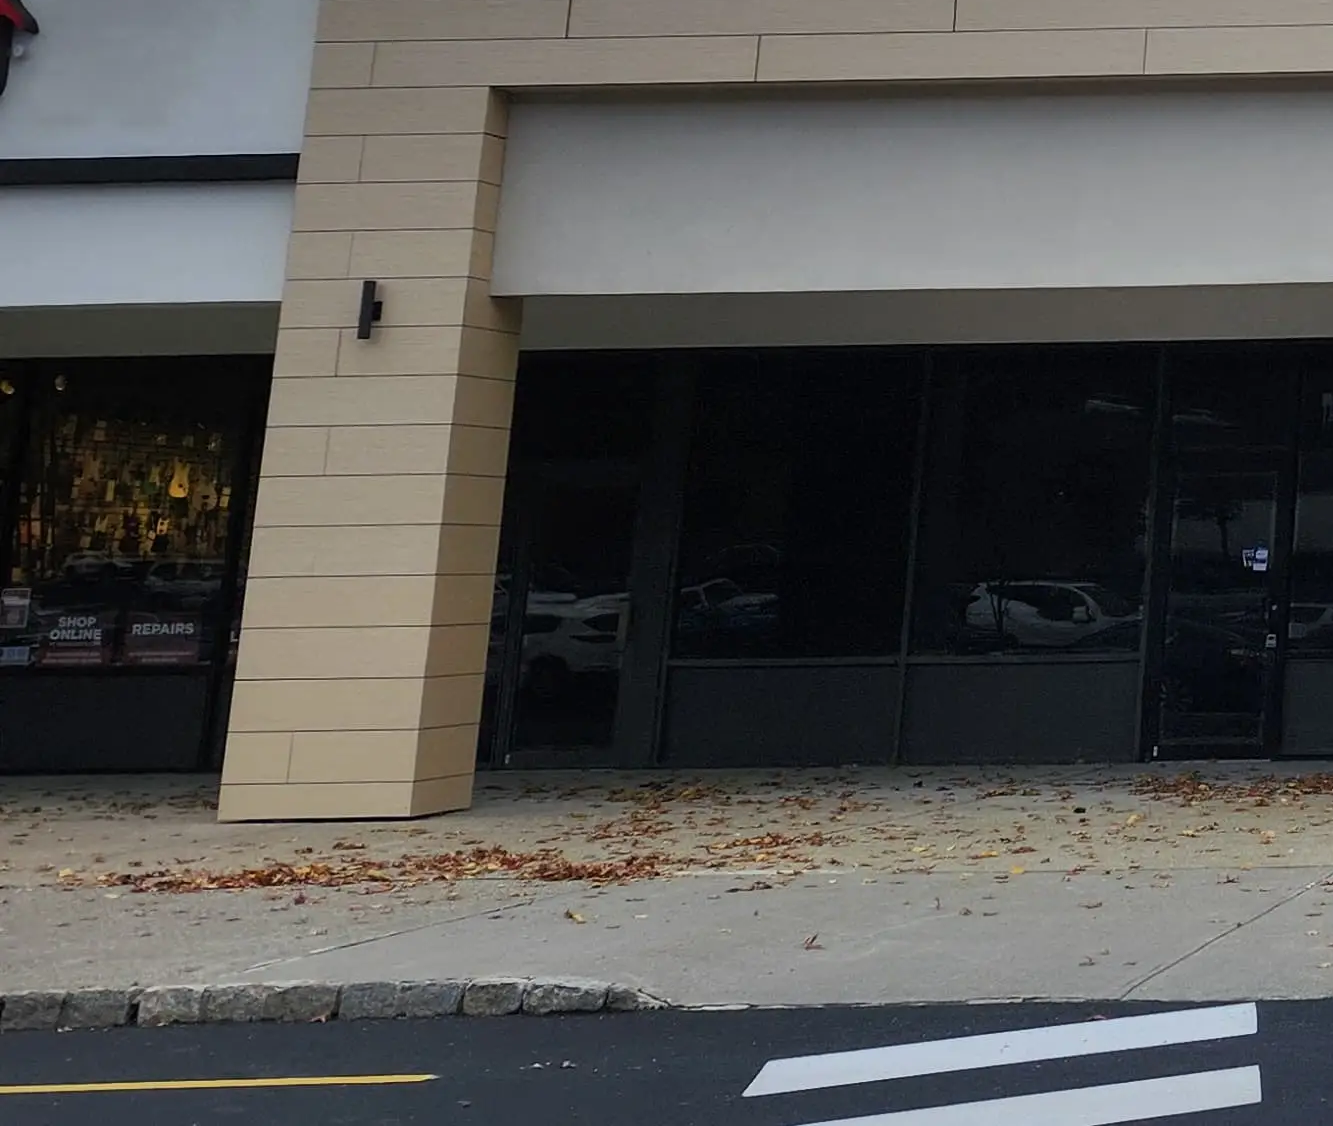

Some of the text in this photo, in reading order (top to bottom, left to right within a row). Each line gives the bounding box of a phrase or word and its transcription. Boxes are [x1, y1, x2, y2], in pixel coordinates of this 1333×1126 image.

[58, 616, 97, 628] SHOP
[49, 628, 103, 640] ONLINE
[131, 622, 195, 635] REPAIRS
